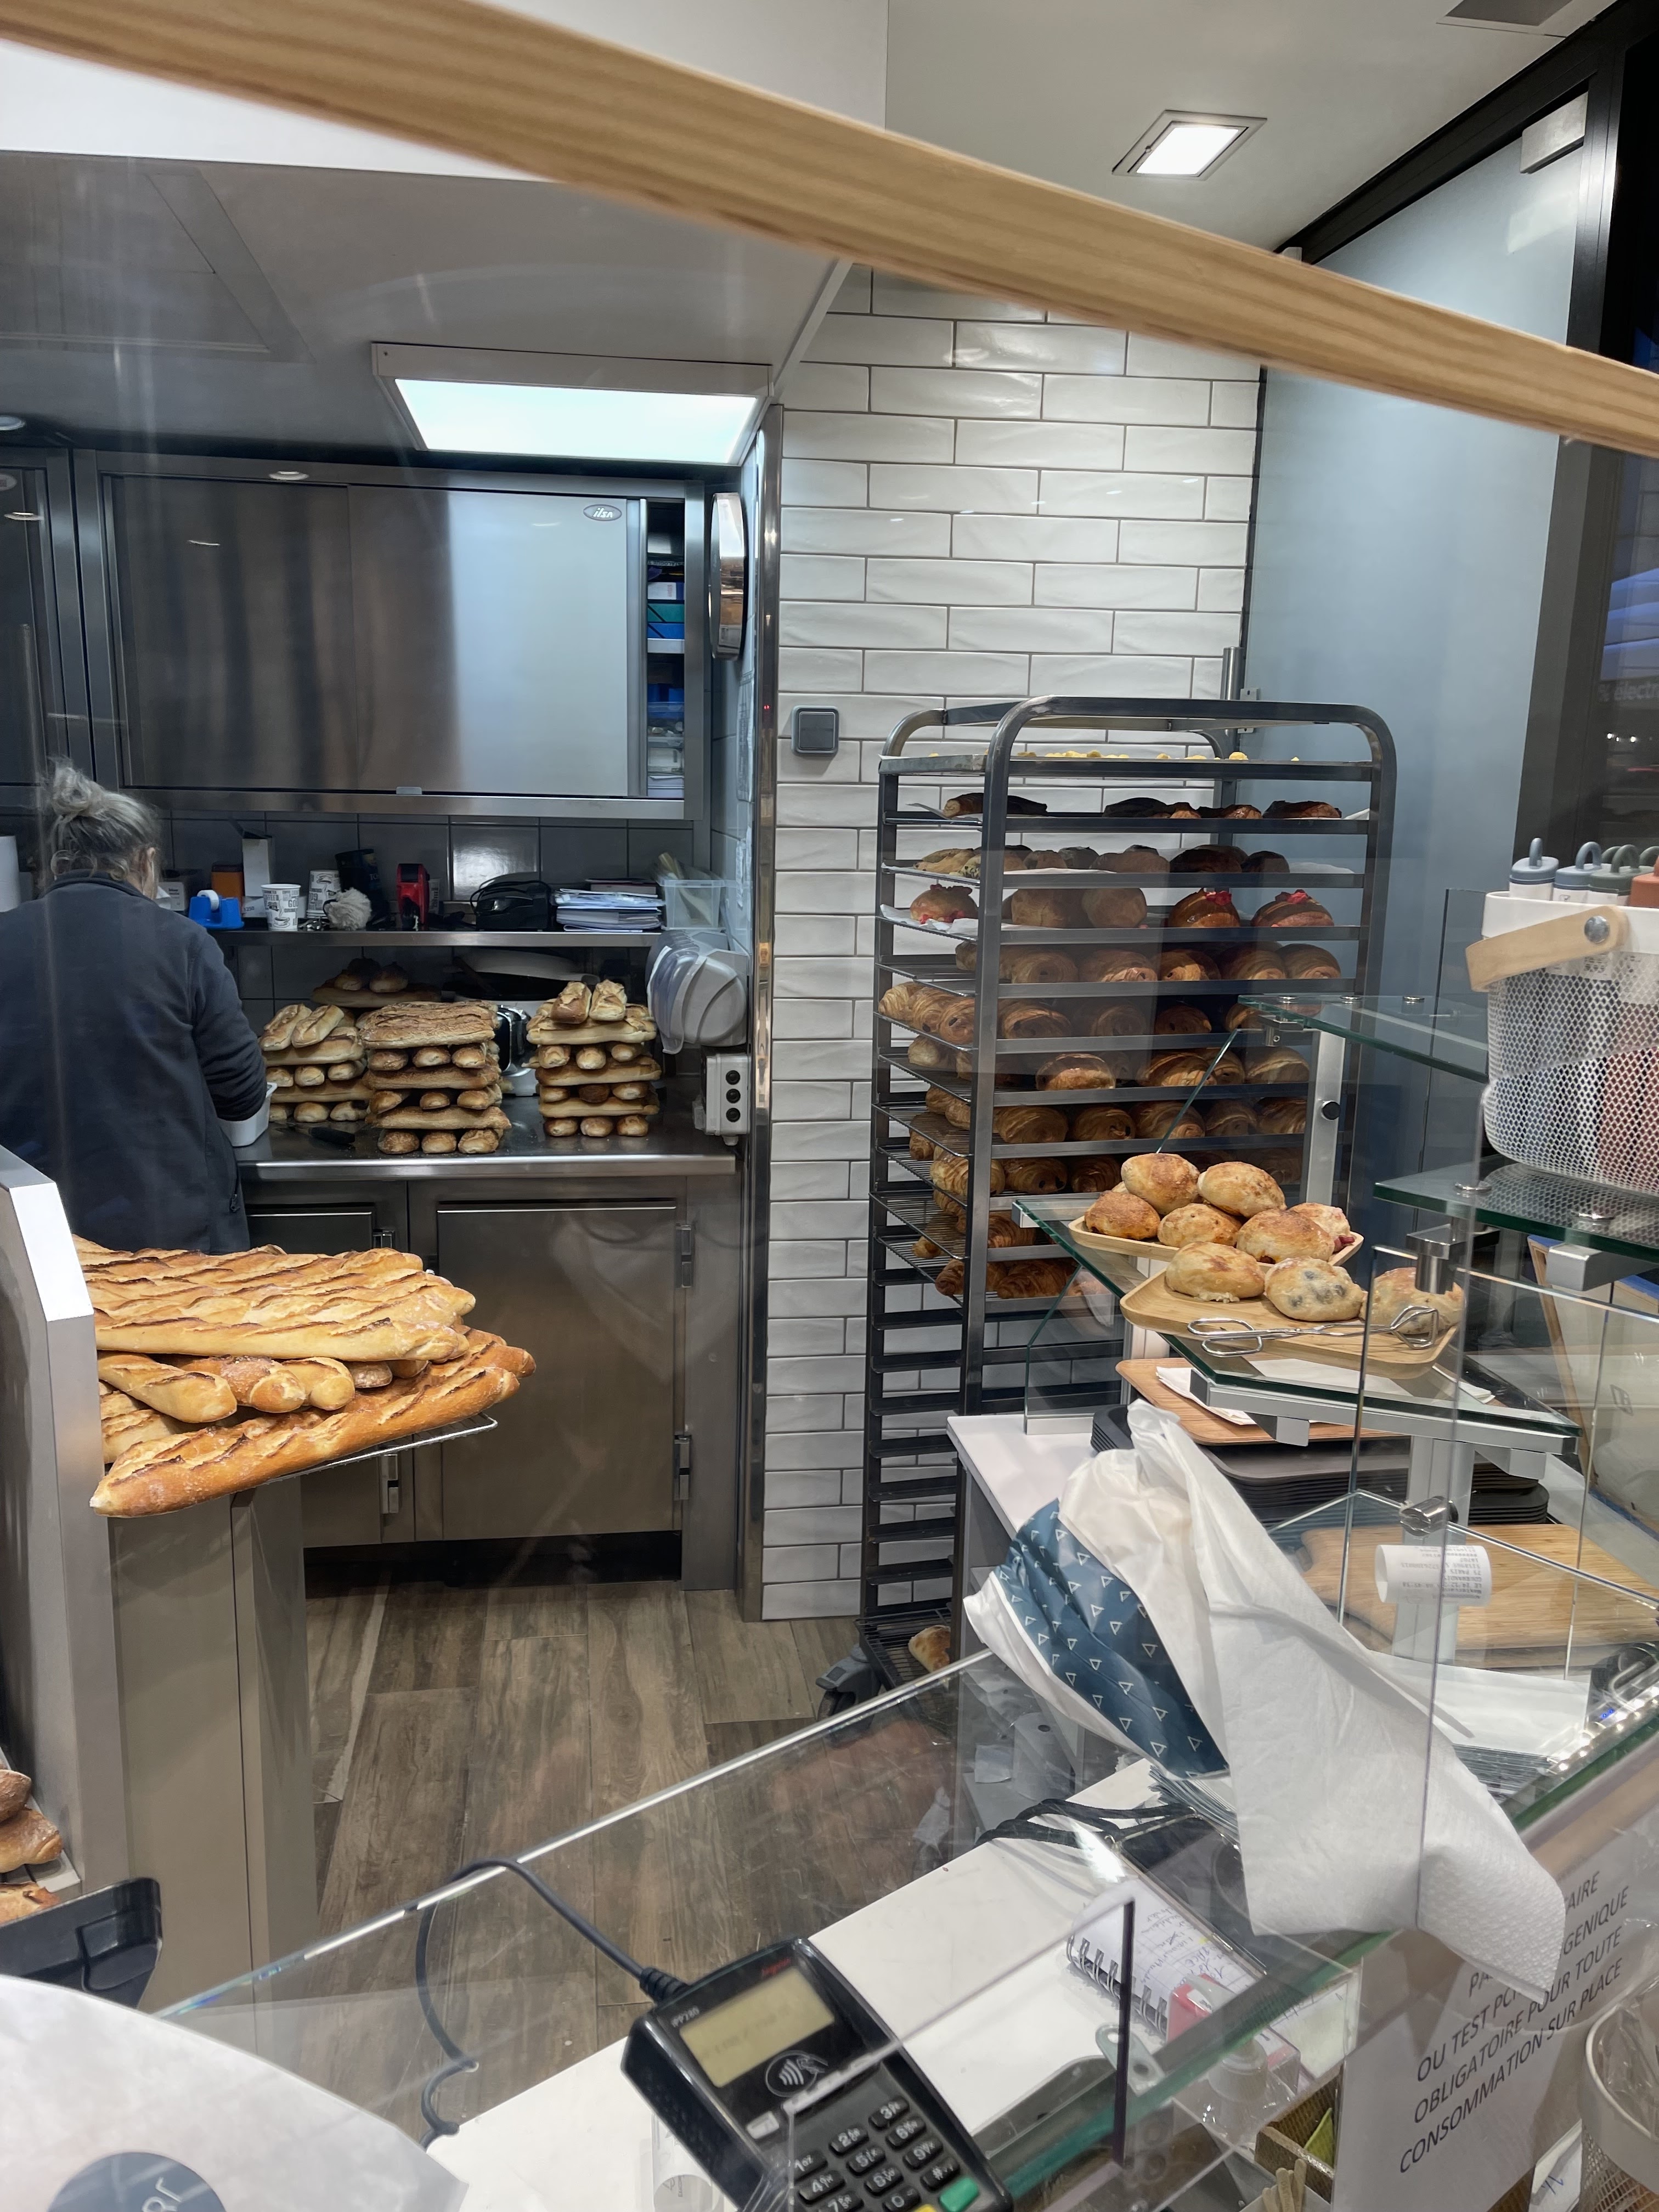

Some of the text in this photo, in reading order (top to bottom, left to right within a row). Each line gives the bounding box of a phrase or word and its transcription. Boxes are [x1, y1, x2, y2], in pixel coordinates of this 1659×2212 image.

[1418, 2044, 1446, 2082] OU
[1452, 2005, 1491, 2055] TEST
[1563, 1886, 1629, 1955] GENIQUE
[1565, 1870, 1600, 1915] AIRE
[1400, 1957, 1622, 2173] CONSOMMATION SUR PLACE
[1414, 1926, 1622, 2124] OBLIGATOIRE POUR TOUTE
